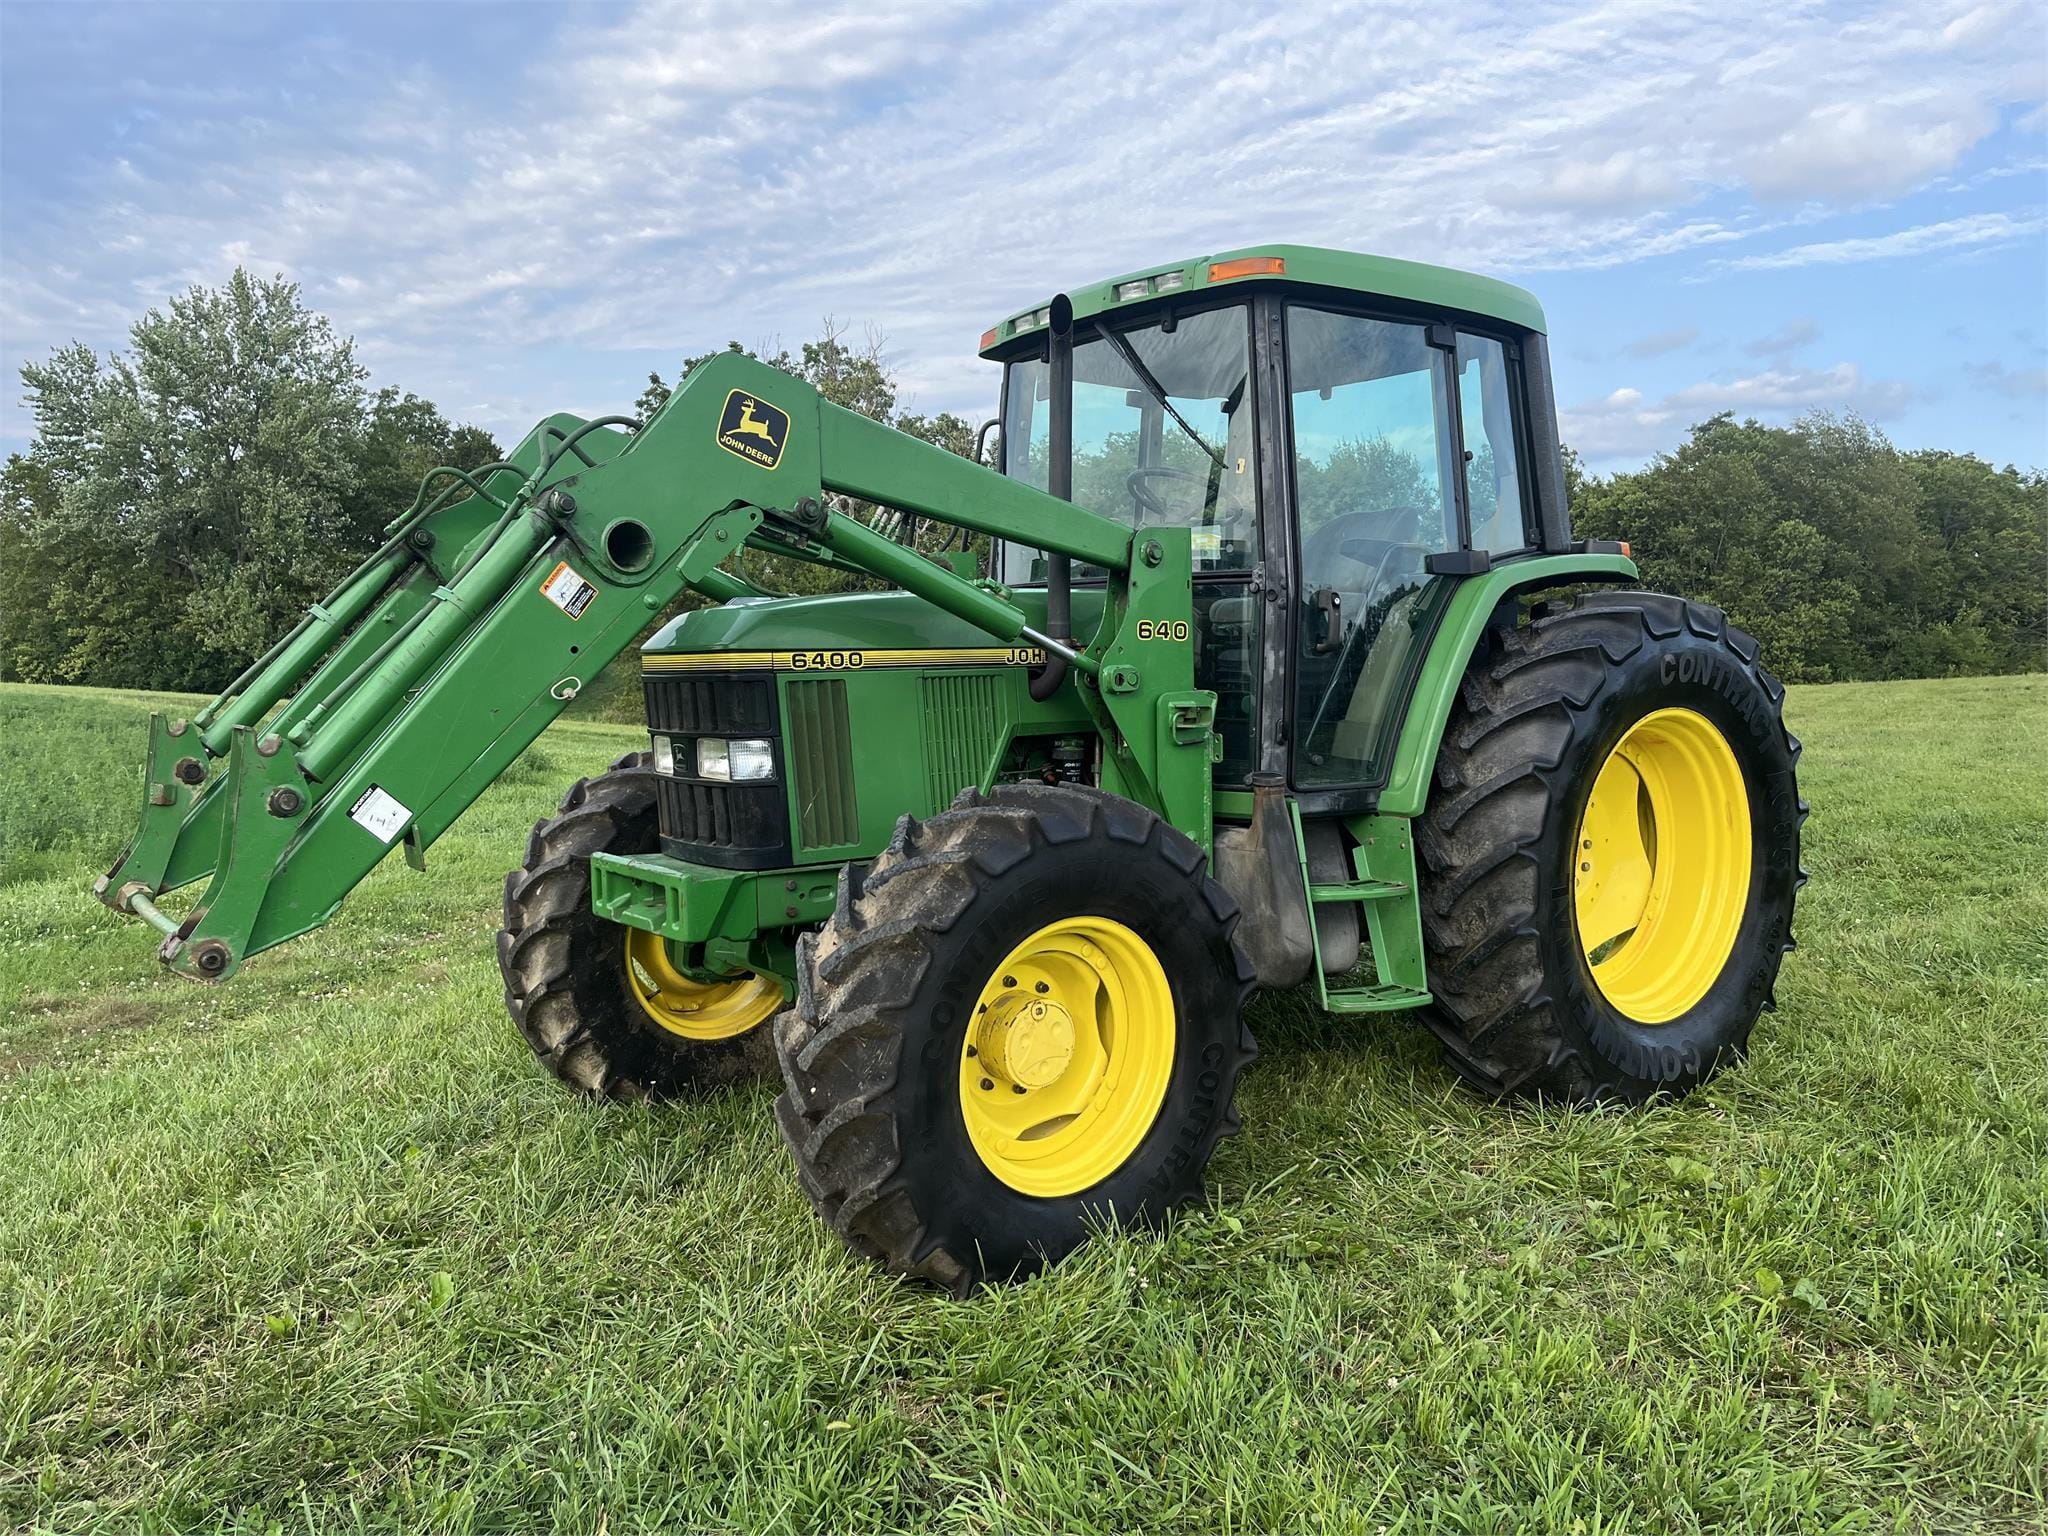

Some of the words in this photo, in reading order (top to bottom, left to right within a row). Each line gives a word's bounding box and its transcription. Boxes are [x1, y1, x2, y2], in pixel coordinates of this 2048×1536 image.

[720, 434, 745, 451] JOHN
[745, 446, 774, 465] DEERE
[1137, 620, 1189, 642] 640
[791, 651, 864, 670] 6400
[1659, 653, 1777, 754] CONTRACT
[350, 788, 374, 813] IMPORTANT
